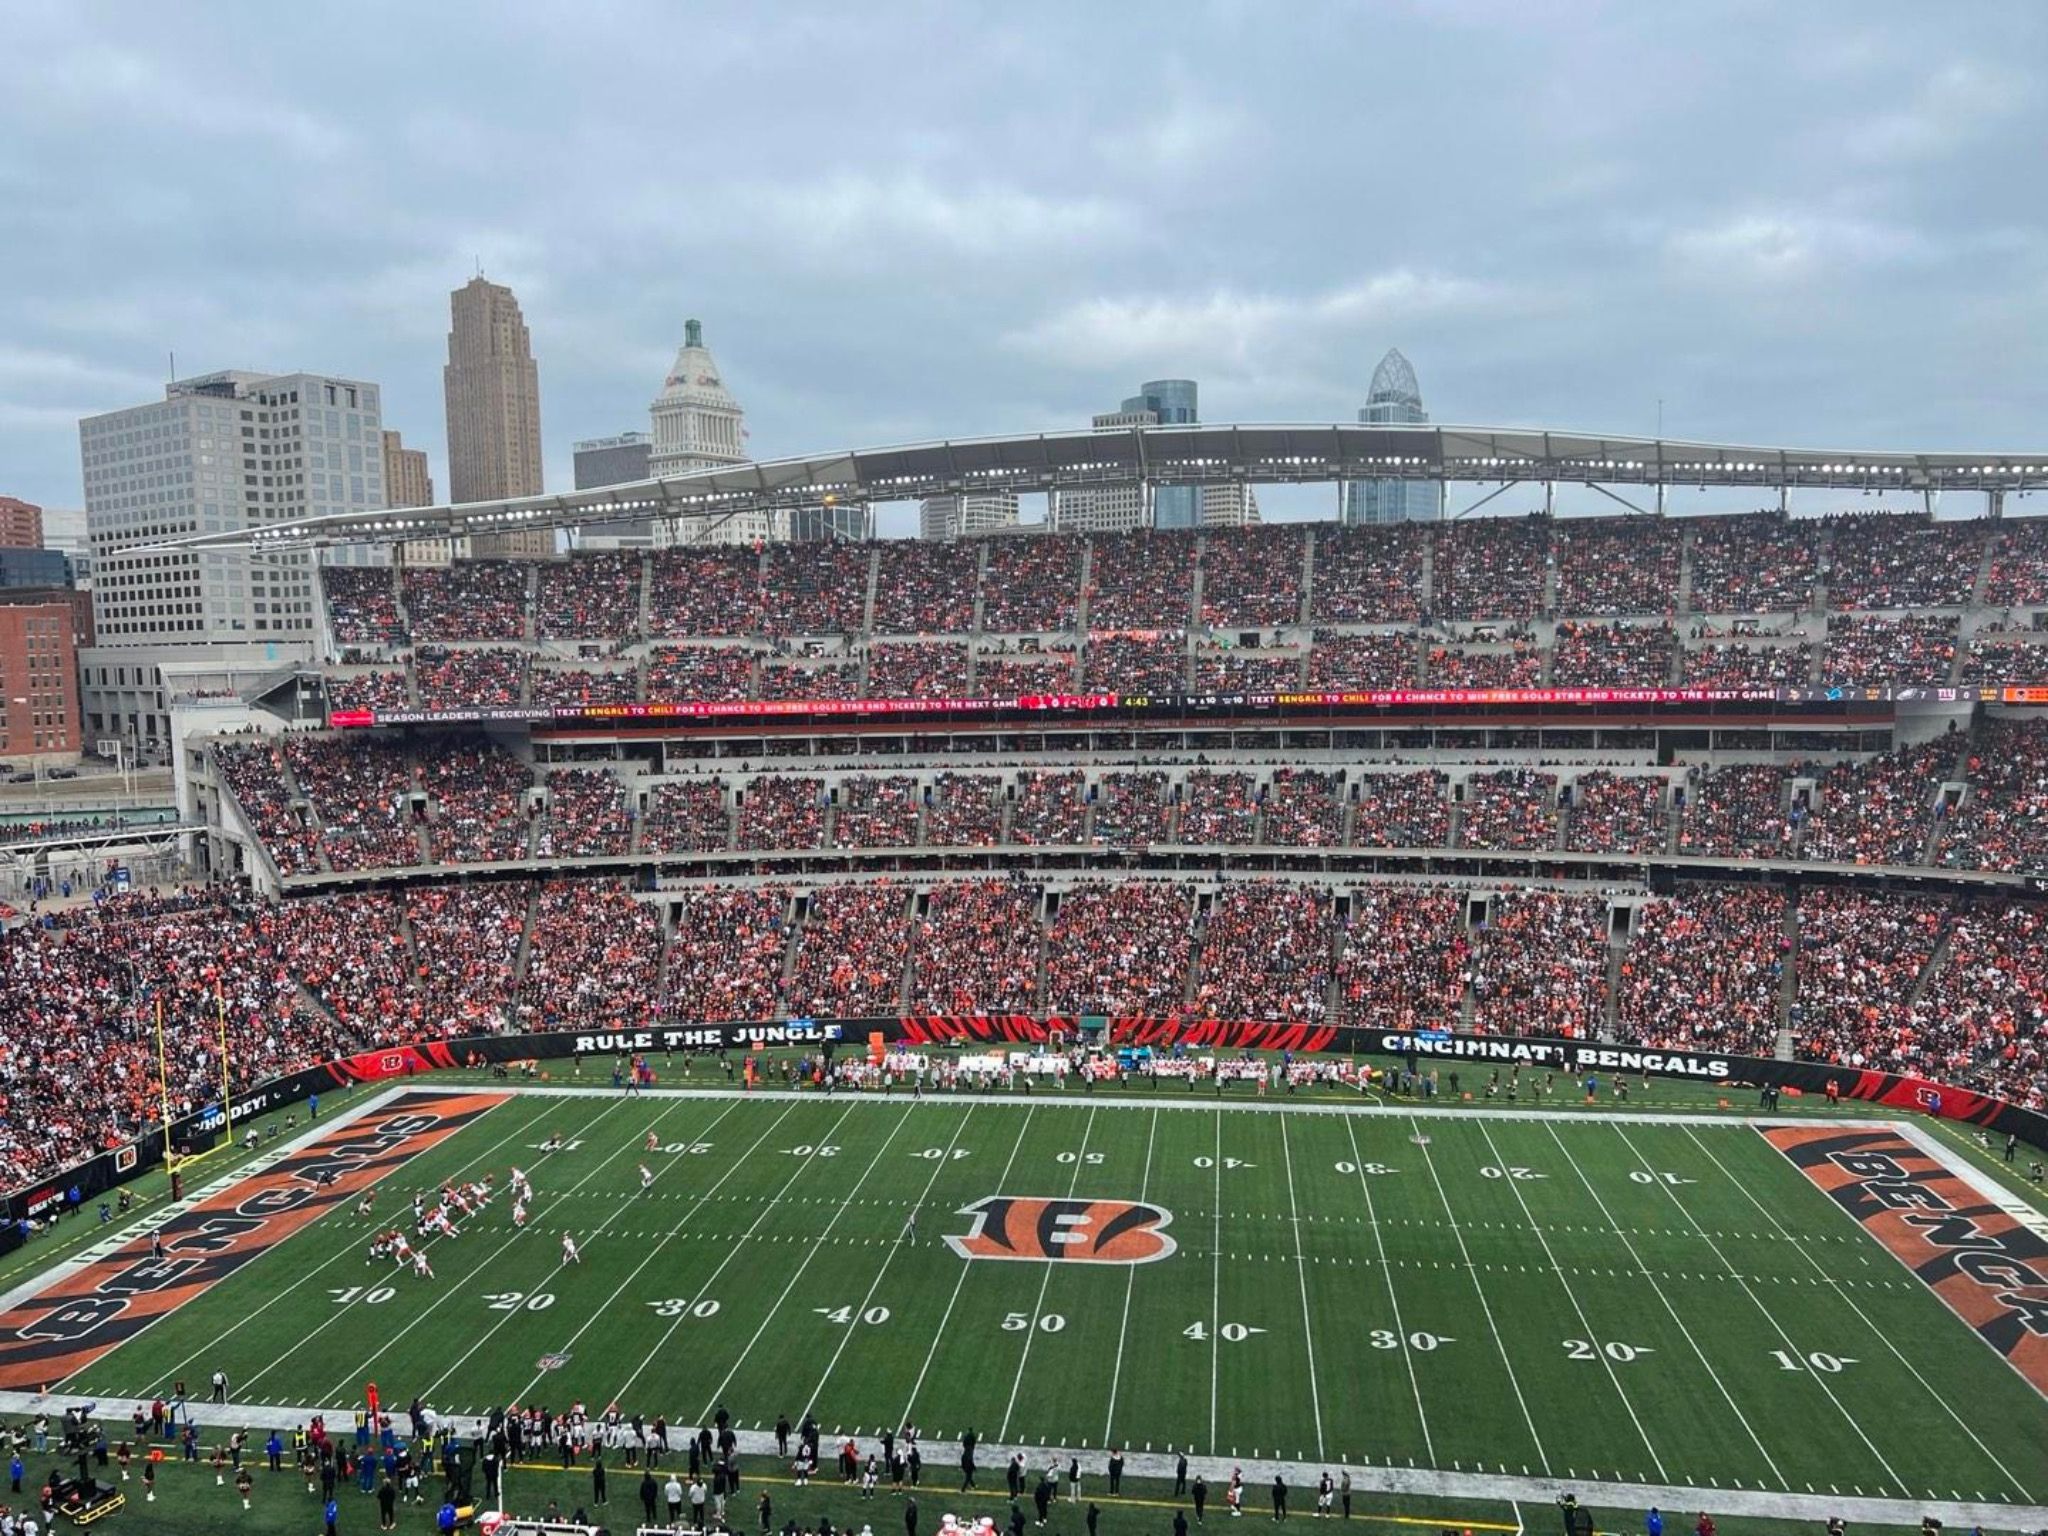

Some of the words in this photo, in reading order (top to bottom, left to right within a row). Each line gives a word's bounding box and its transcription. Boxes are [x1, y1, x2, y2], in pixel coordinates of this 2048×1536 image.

[1125, 697, 1148, 706] 4:43
[1251, 695, 1276, 704] TEXT
[1279, 694, 1322, 703] BENGALS
[1326, 694, 1338, 703] TO
[1342, 694, 1369, 702] CHILI
[1372, 694, 1391, 702] FOR
[1406, 693, 1446, 701] CHANCE
[1450, 693, 1464, 701] TO
[1467, 692, 1488, 700] WIN
[1522, 692, 1550, 700] GOLD
[1554, 691, 1582, 700] STAR
[1586, 691, 1608, 699] AND
[1612, 691, 1656, 699] TICKETS
[1662, 691, 1676, 699] TO
[1681, 691, 1704, 699] THE
[1707, 690, 1738, 699] NEXT
[1741, 690, 1775, 699] GAME
[377, 713, 424, 722] SEASON
[427, 711, 479, 721] LEADERS
[491, 709, 550, 719] RECEIVING
[556, 708, 581, 717] TEXT
[584, 707, 628, 716] BENGALS
[631, 707, 644, 715] TO
[647, 706, 674, 715] CHILI
[676, 706, 695, 714] FOR
[708, 705, 745, 713] CHANCE
[748, 704, 761, 713] TO
[867, 702, 886, 711] AND
[889, 702, 926, 711] TICKETS
[945, 701, 962, 709] THE
[965, 700, 989, 709] NEXT
[992, 700, 1018, 708] GAME
[576, 1033, 652, 1051] RULE
[663, 1028, 722, 1046] THE
[732, 1025, 842, 1043] JUNGLE
[1576, 1048, 1730, 1077] BENGALS
[229, 1094, 267, 1120] DEY!
[15, 1113, 442, 1341] BENGALS
[106, 1205, 185, 1244] TAKES
[330, 1286, 397, 1304] 10
[488, 1291, 556, 1311] 20
[654, 1298, 721, 1318] 30
[827, 1304, 890, 1325] 40
[1000, 1312, 1066, 1333] 50
[1182, 1321, 1249, 1342] 40
[1369, 1329, 1438, 1351] 30
[1561, 1339, 1636, 1362] 20
[1768, 1350, 1843, 1373] 10
